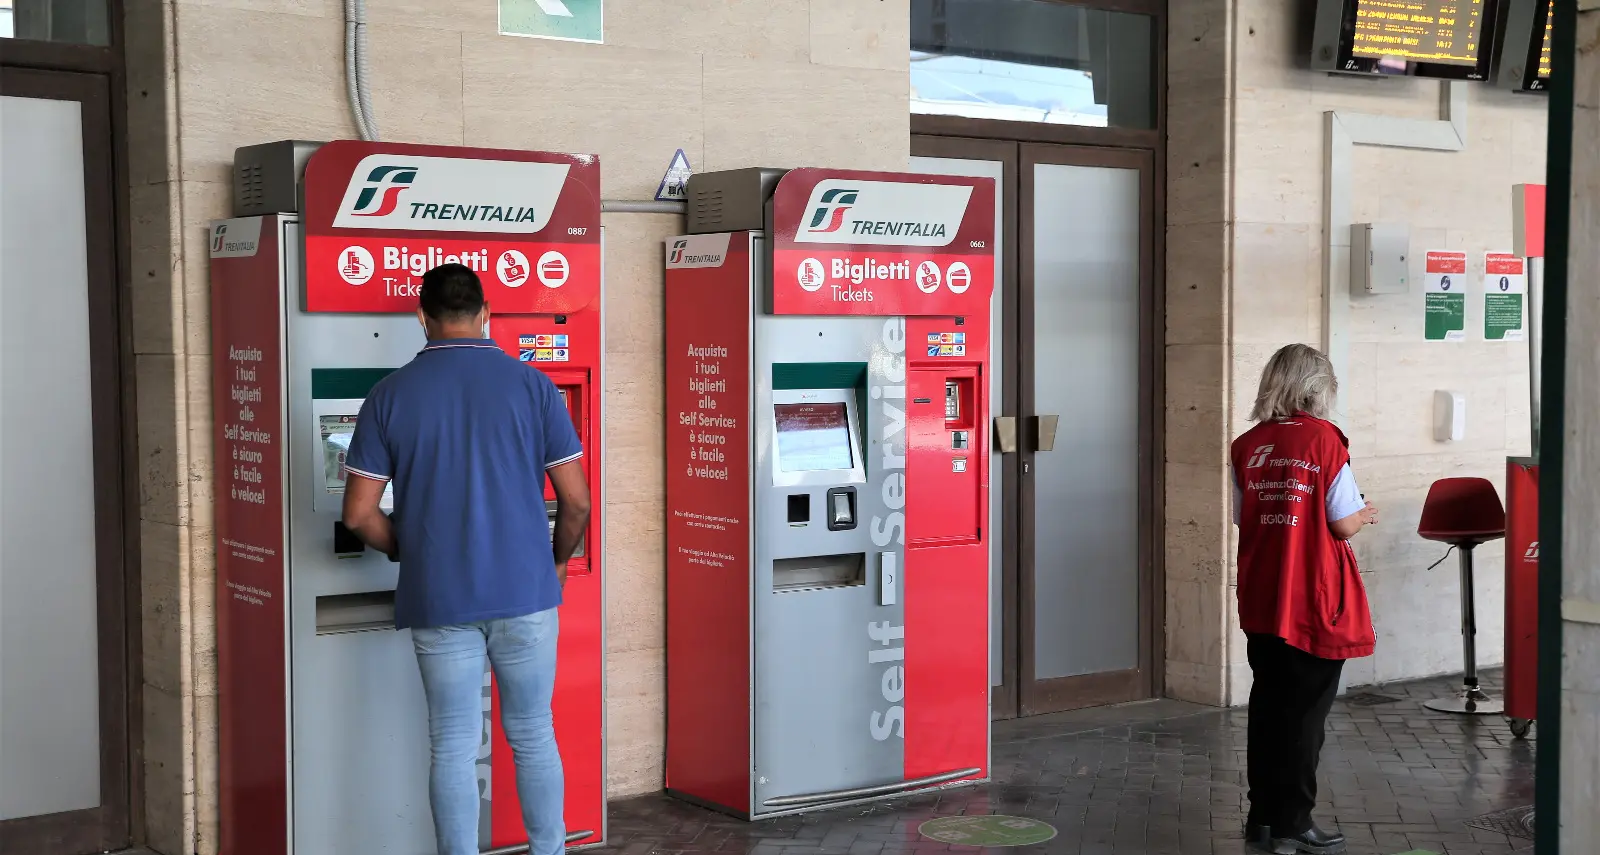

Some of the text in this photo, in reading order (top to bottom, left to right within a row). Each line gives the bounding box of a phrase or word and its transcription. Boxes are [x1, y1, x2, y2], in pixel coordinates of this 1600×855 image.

[410, 202, 535, 223] TRENITALIA
[567, 226, 588, 236] 0887
[852, 220, 946, 238] TRENITALIA
[225, 241, 255, 252] TRENITALIA
[970, 240, 985, 248] 0662
[684, 254, 721, 264] TRENITALIA
[831, 258, 910, 284] Biglietti
[382, 277, 424, 297] Ticke
[830, 285, 874, 302] Tickets
[230, 344, 262, 364] Acquista
[688, 344, 728, 360] Acquista
[236, 366, 256, 382] i tuoi
[695, 361, 720, 374] i tuoi
[232, 384, 262, 404] biglietti
[689, 377, 726, 394] biglietti
[698, 396, 716, 409] alle
[240, 406, 254, 422] alle
[680, 412, 736, 428] Self Service:
[225, 424, 271, 444] Self Service:
[689, 430, 726, 445] è sicuro
[870, 316, 906, 547] Service
[233, 445, 262, 463] è sicuro
[690, 447, 725, 462] è facile
[234, 466, 262, 483] è facile
[687, 463, 728, 480] è veloce!
[1270, 459, 1320, 474] TRENITALIA
[232, 484, 265, 504] è veloce!
[1286, 478, 1314, 495] Clienti
[868, 620, 905, 742] Self
